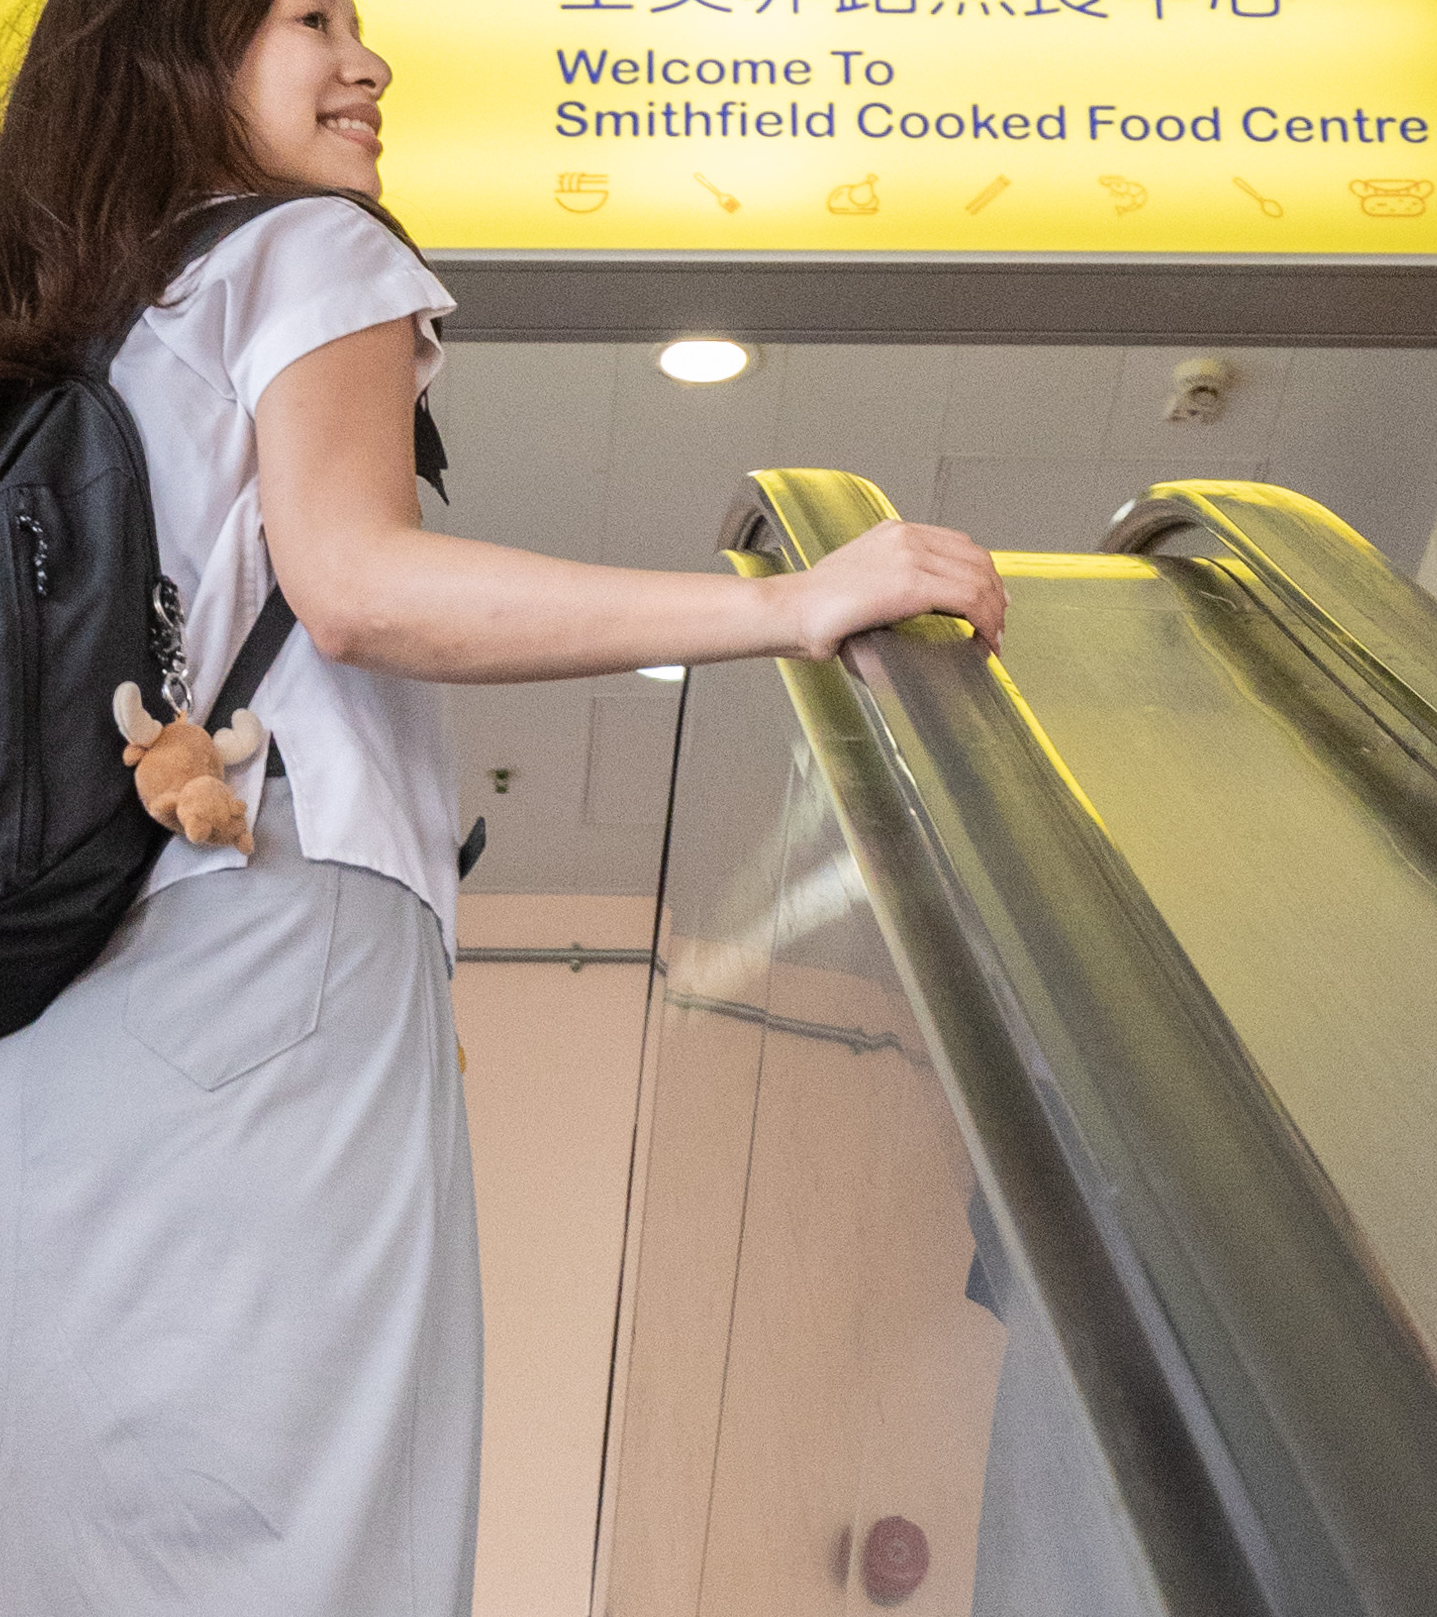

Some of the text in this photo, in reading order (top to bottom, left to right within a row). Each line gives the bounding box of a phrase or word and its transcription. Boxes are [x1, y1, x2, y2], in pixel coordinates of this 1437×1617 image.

[555, 49, 896, 86] Welcome To
[555, 101, 1431, 144] Smithfield Cooked Food Centre
